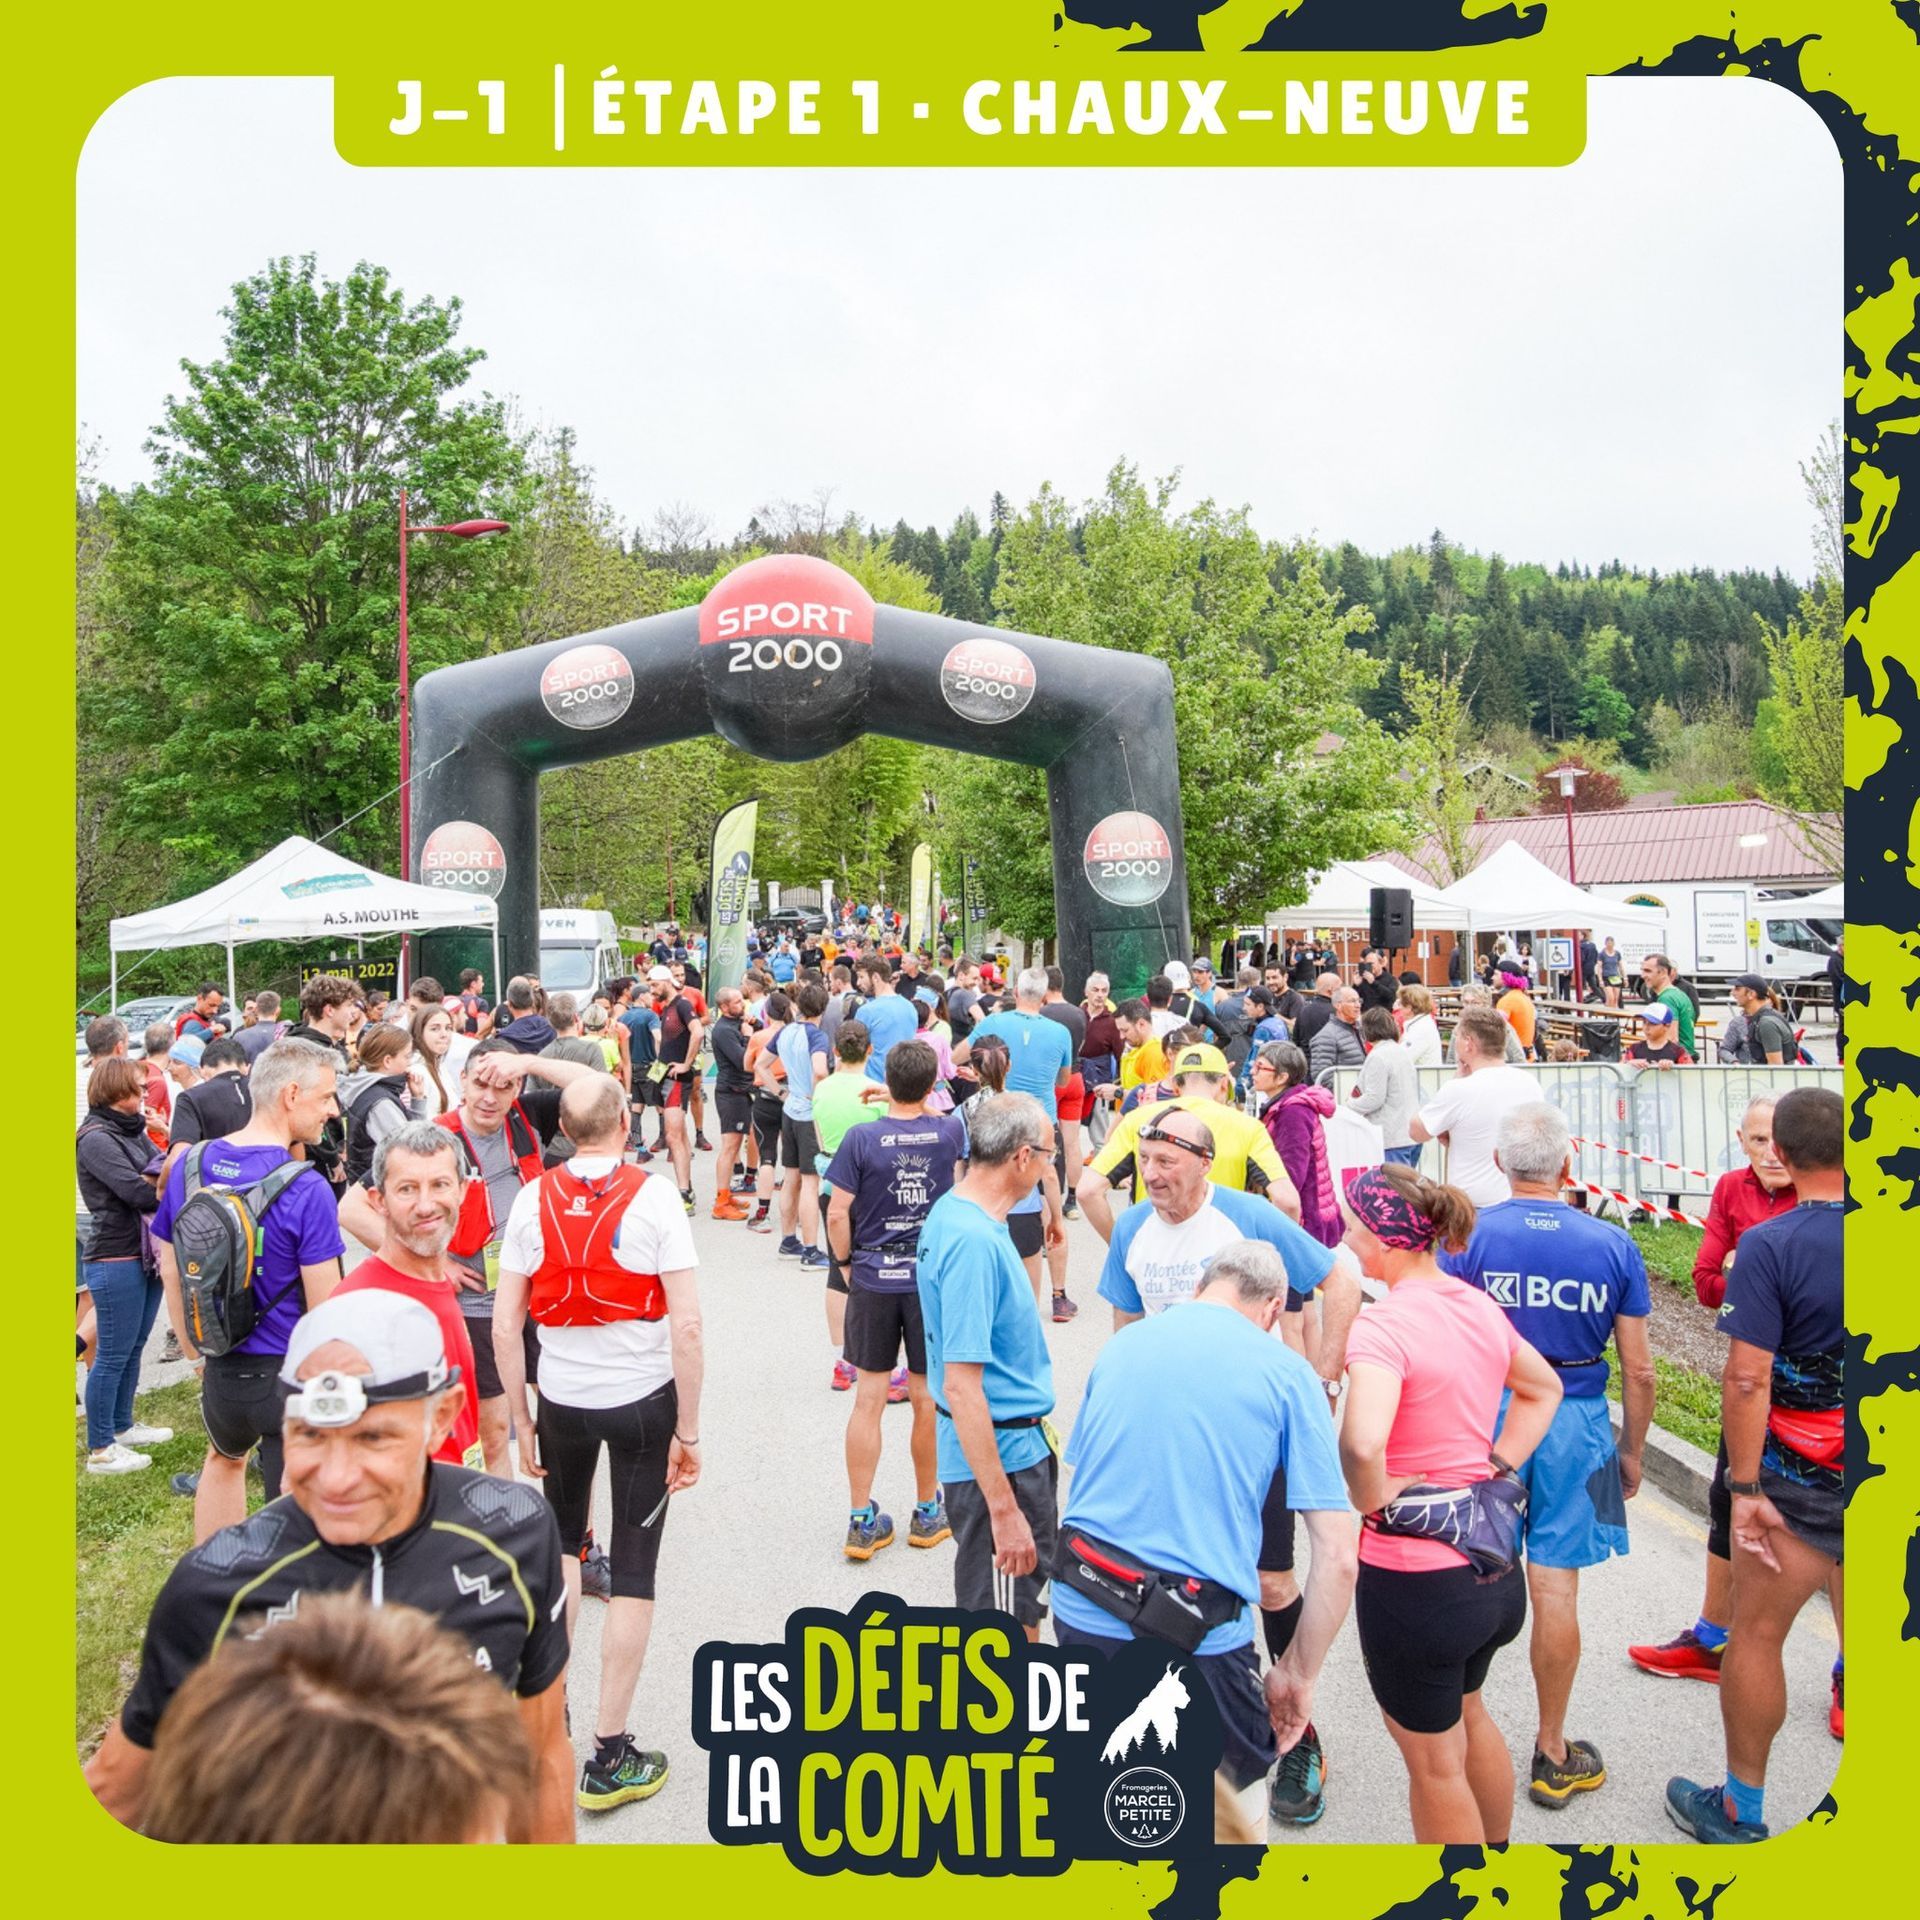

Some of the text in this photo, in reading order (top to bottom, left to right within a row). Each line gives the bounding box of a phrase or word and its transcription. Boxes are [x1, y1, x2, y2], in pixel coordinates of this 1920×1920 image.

[717, 601, 853, 637] SPORT
[728, 638, 843, 673] 2000
[548, 660, 621, 691] SPORT
[953, 655, 1028, 682] SPORT
[559, 680, 619, 708] 2000
[955, 674, 1016, 700] 2000
[427, 850, 497, 868] SPORT
[1092, 840, 1164, 859] SPORT
[431, 869, 490, 886] 2000
[1101, 859, 1161, 878] 2000
[323, 908, 420, 925] A.S. MOUTHE
[326, 964, 354, 979] mai
[358, 962, 395, 979] 2022
[896, 1188, 930, 1205] TRAIL
[1524, 1217, 1561, 1229] CLIQUE
[1144, 1260, 1197, 1278] Montée
[1144, 1277, 1196, 1294] du Pou
[1526, 1275, 1609, 1314] BCN
